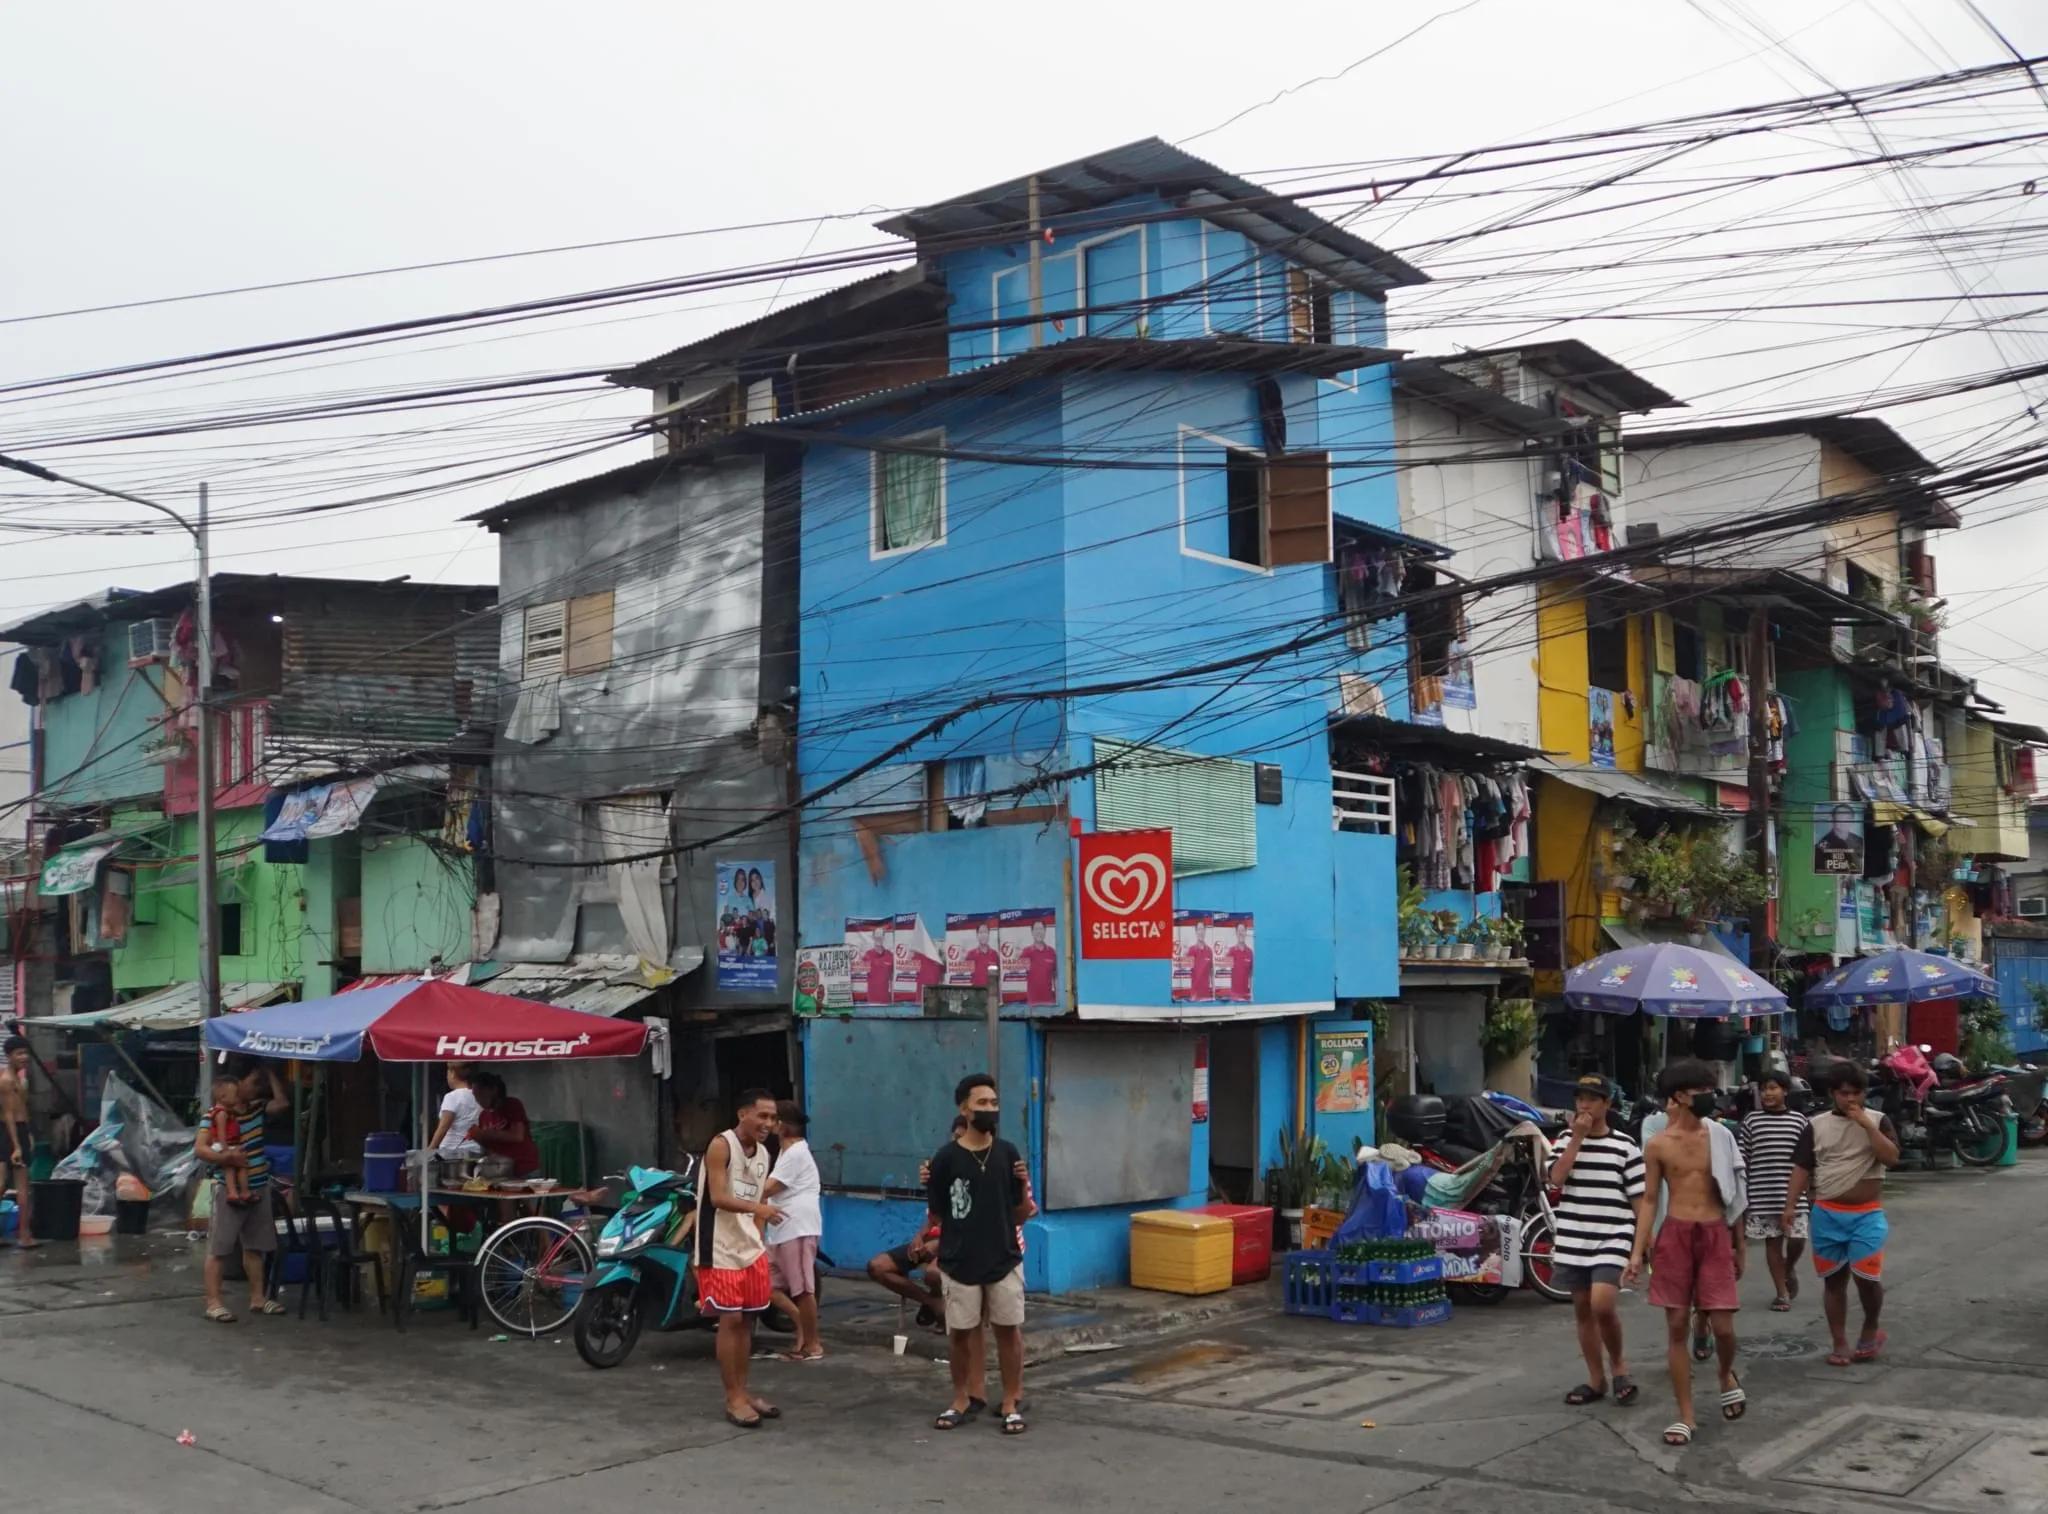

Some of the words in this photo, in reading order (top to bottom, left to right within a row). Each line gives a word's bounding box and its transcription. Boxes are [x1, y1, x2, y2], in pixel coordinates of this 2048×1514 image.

[1092, 920, 1161, 940] SELECTA
[238, 1029, 324, 1055] Homstar
[435, 1035, 580, 1057] Homstar
[1320, 1038, 1364, 1049] ROLLBACK
